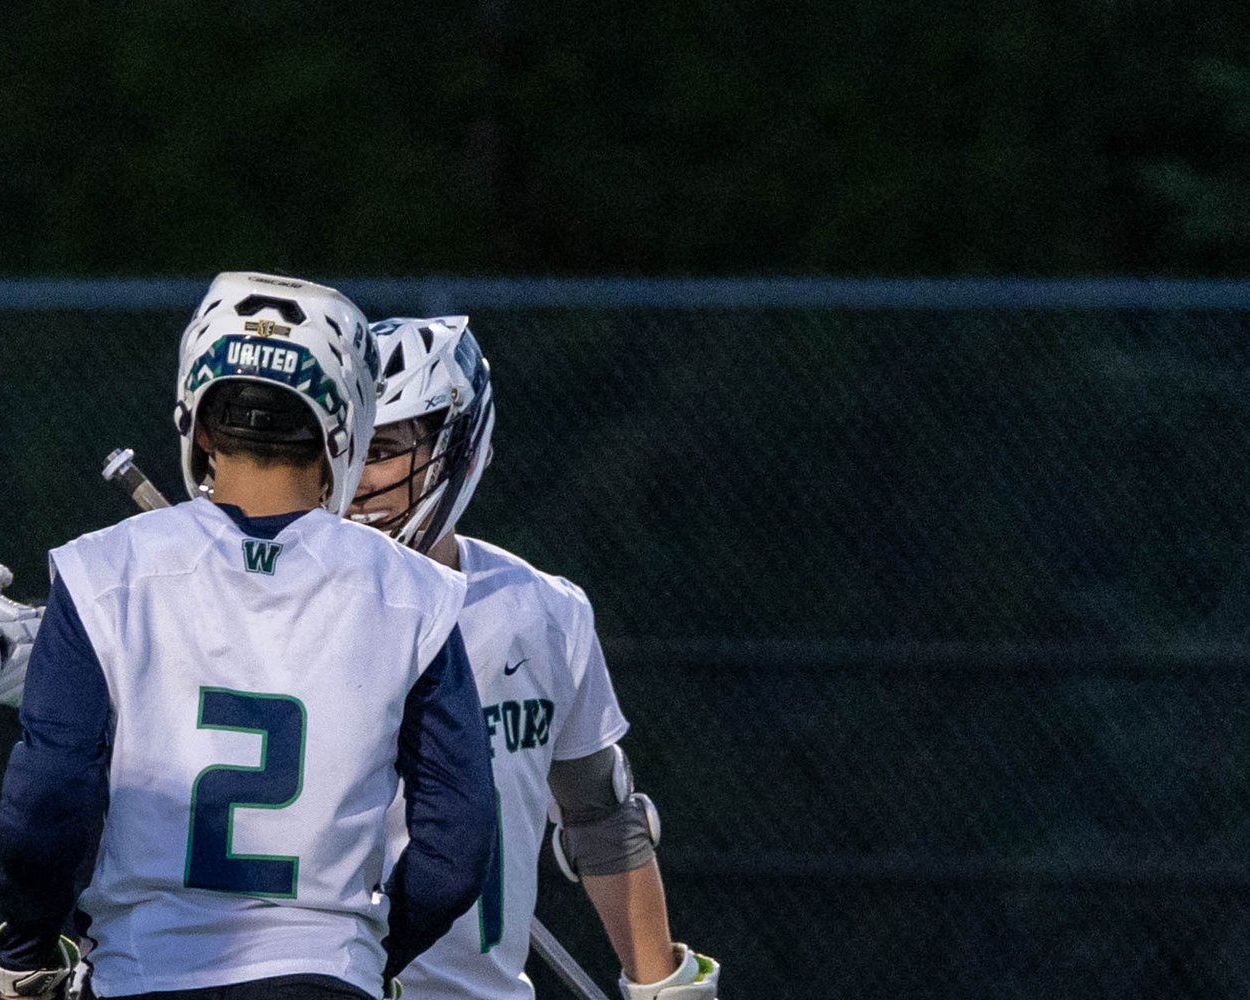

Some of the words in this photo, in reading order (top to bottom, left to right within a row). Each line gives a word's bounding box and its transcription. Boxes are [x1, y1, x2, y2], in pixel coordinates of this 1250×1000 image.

[227, 340, 299, 374] UNITED
[242, 538, 283, 576] W
[183, 685, 308, 899] 2
